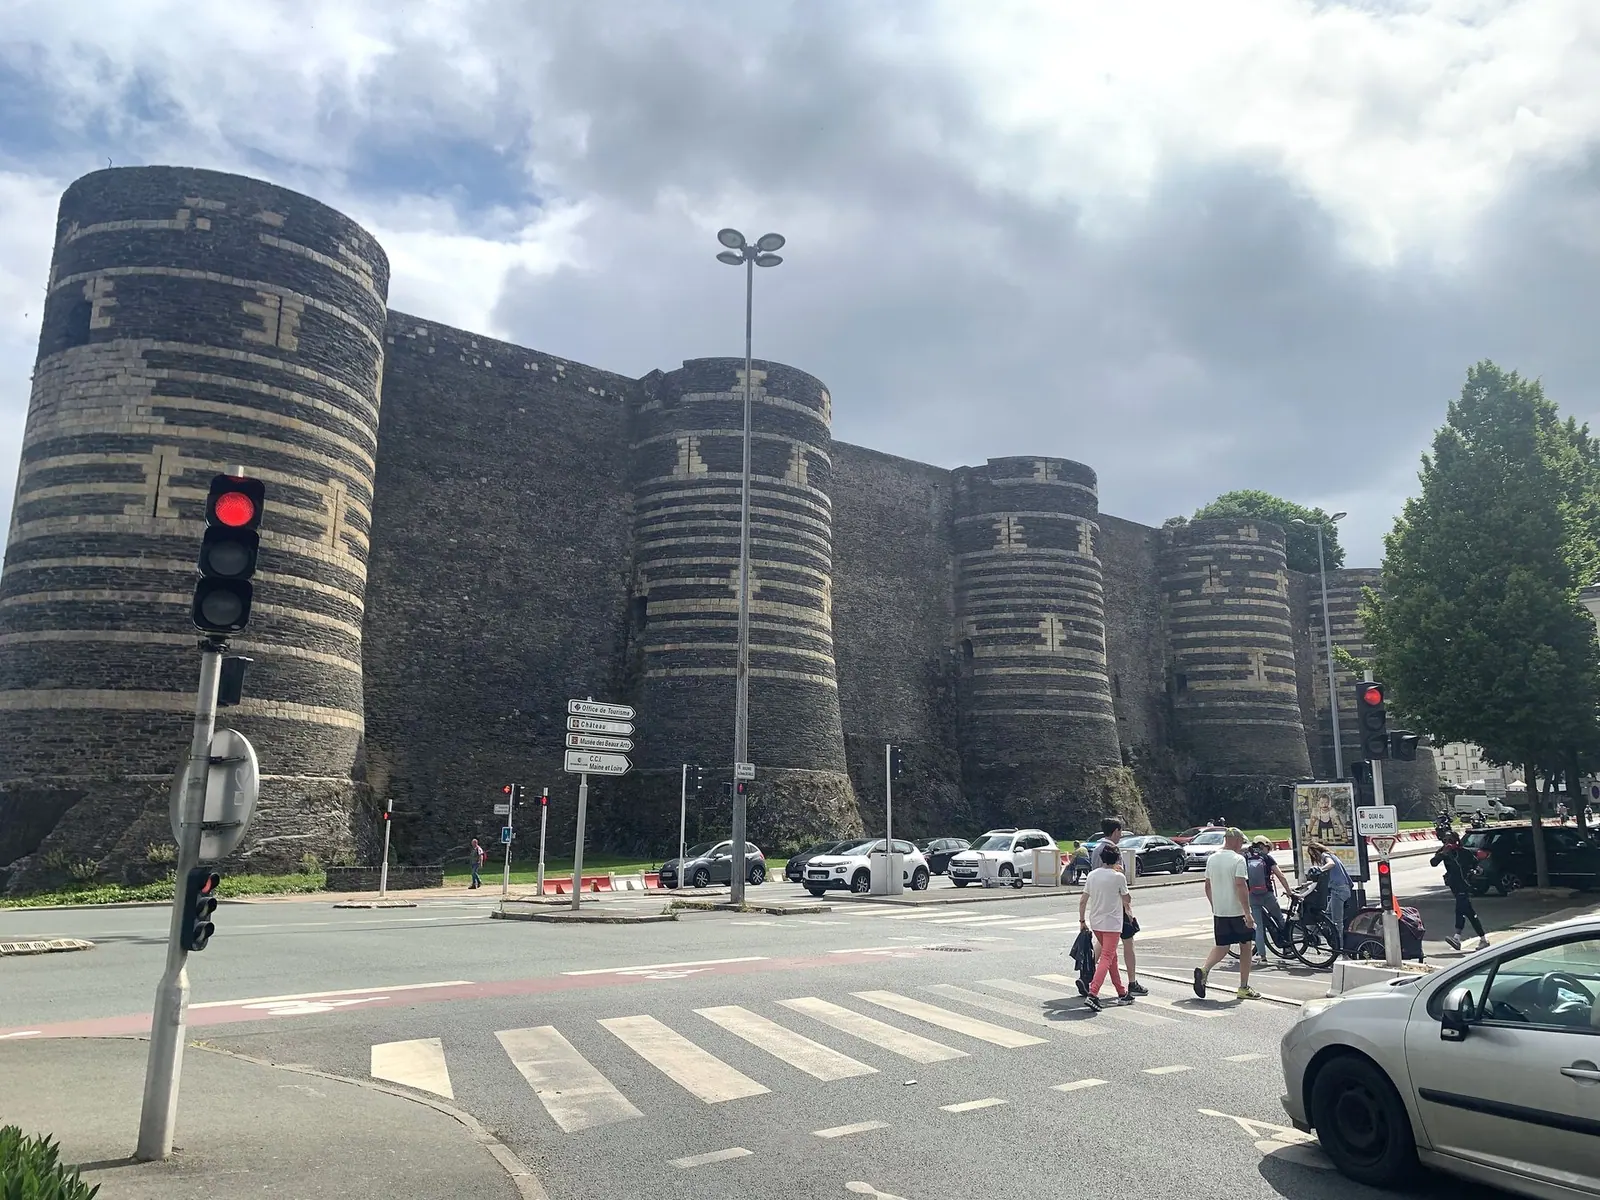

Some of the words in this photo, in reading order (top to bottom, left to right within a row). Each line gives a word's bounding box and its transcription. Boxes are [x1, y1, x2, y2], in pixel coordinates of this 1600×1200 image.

[582, 704, 598, 713] Office
[608, 708, 630, 716] Tourisme
[581, 721, 606, 729] Château
